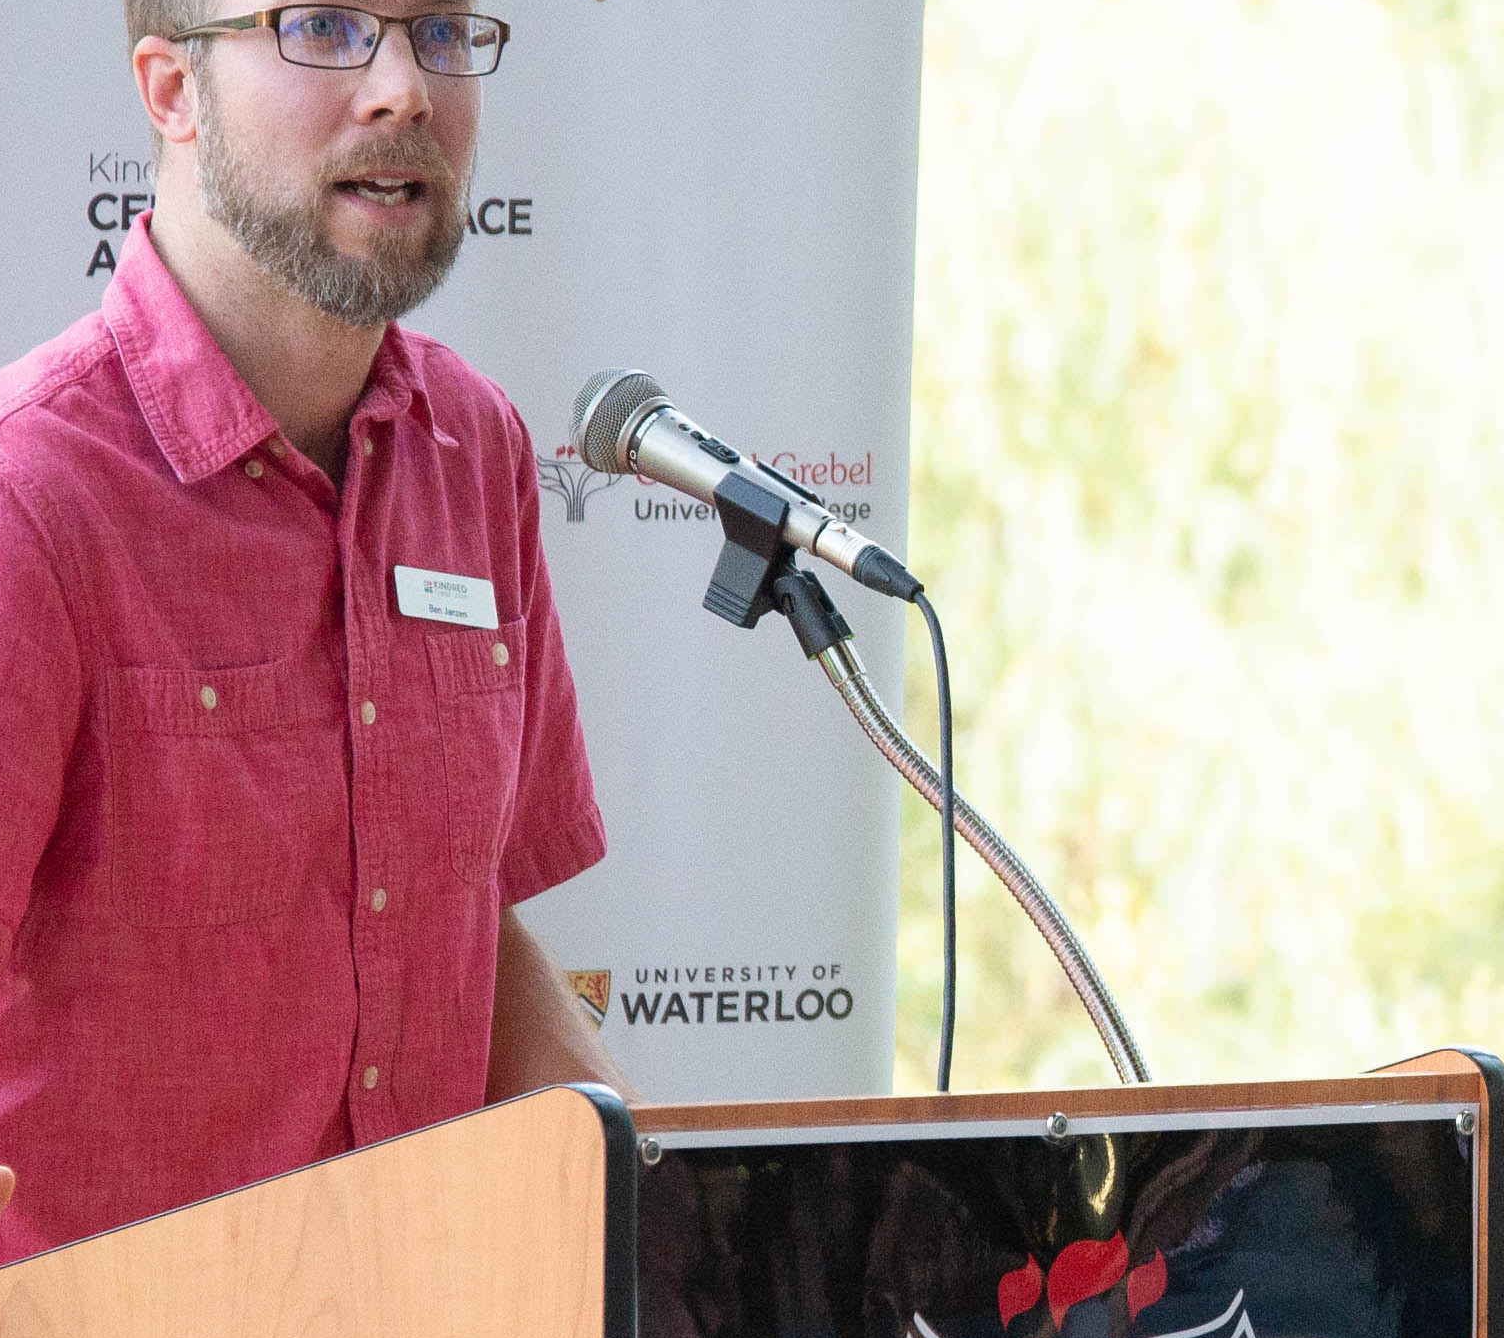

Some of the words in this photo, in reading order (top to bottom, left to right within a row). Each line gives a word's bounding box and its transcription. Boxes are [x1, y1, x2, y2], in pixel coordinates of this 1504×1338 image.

[771, 451, 873, 487] Grebel
[635, 965, 797, 984] UNIVERSITY
[812, 964, 842, 981] OF
[620, 987, 854, 1026] WATERLOO
